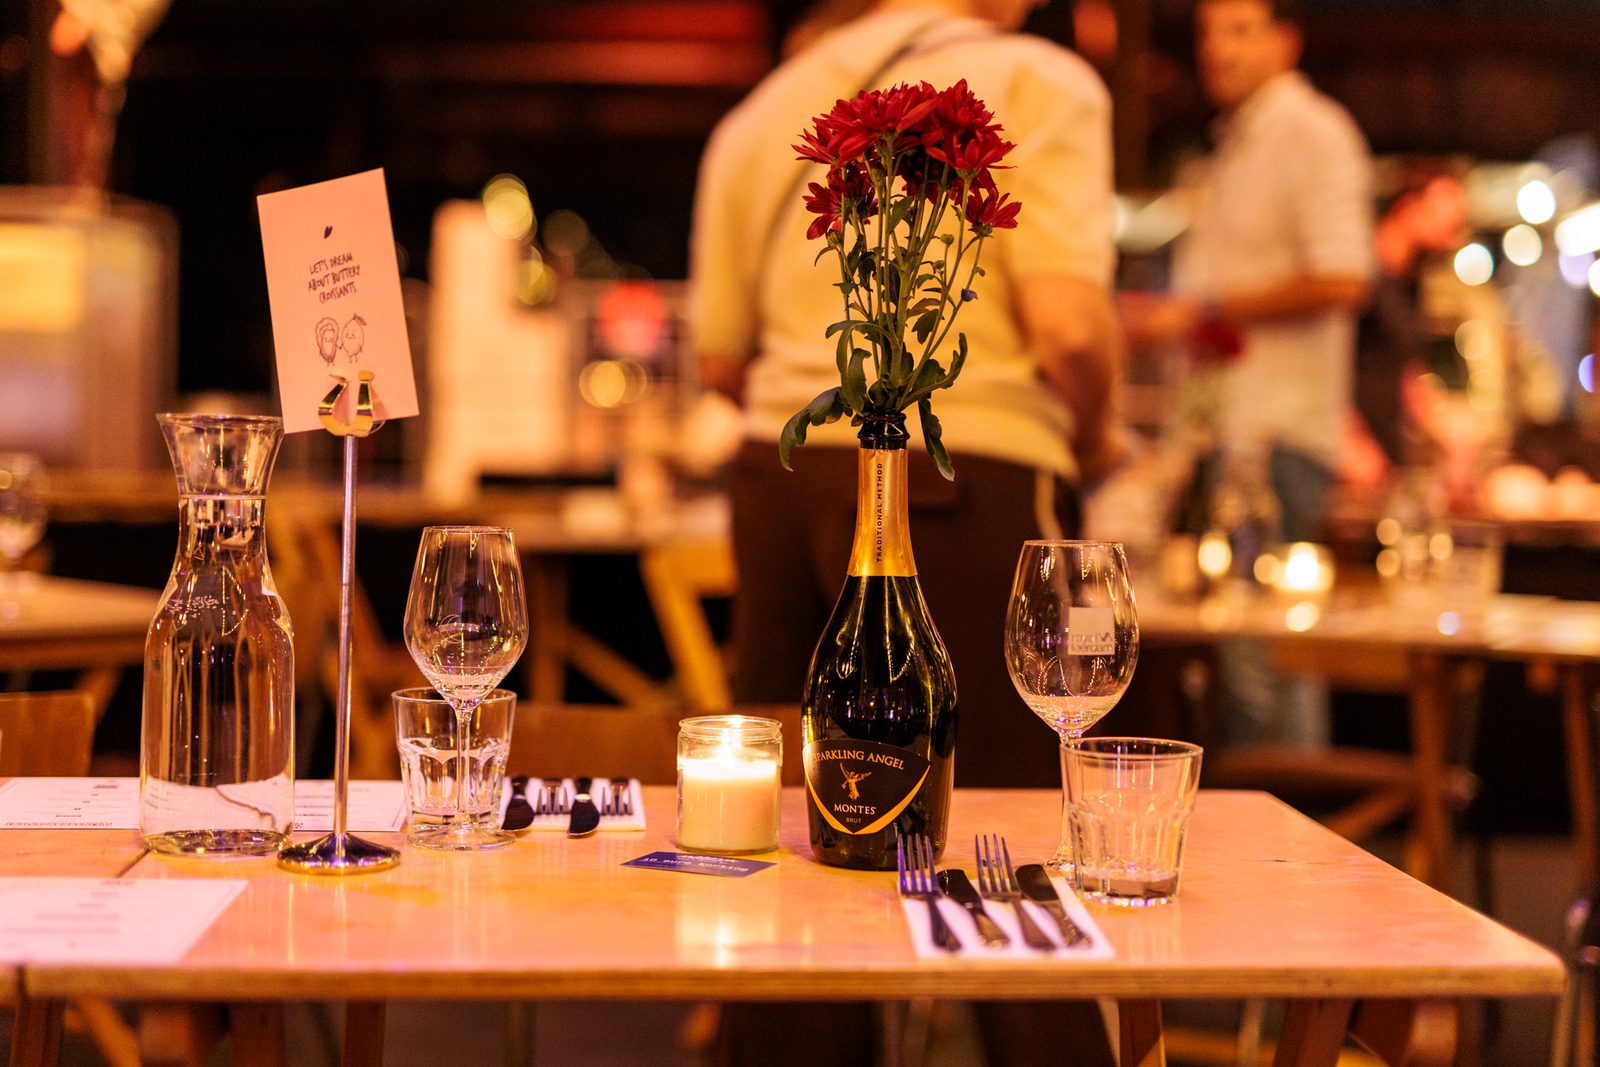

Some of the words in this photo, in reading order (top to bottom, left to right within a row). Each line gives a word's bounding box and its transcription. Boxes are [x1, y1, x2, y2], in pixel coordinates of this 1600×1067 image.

[309, 259, 328, 275] LET'S
[329, 252, 353, 268] DREAM
[308, 273, 330, 292] ABOUT
[331, 264, 360, 285] BUTTERY
[319, 281, 357, 304] CROISSANTS
[813, 750, 864, 762] SPARKLING
[867, 753, 904, 770] ANGEL
[834, 804, 876, 815] MONTES
